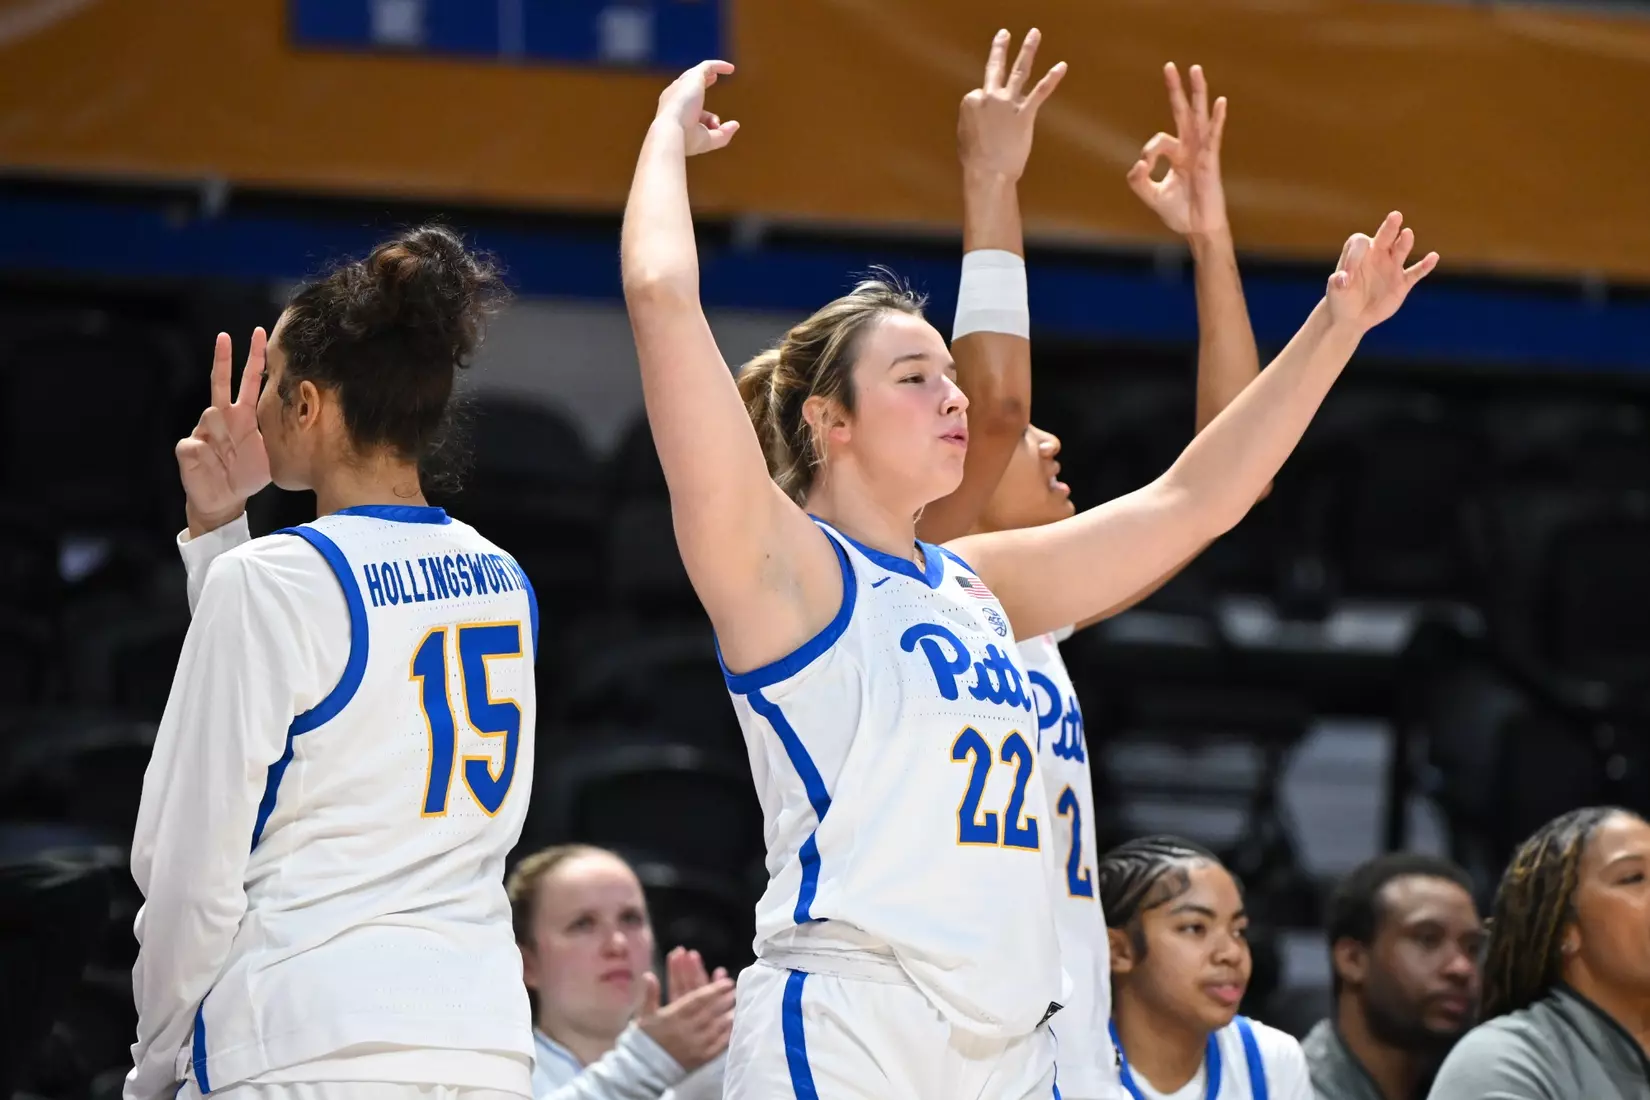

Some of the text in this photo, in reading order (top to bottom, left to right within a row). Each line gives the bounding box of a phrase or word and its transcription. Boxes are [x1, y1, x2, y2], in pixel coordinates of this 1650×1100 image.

[408, 619, 524, 818] 15
[900, 622, 1032, 713] Pitt
[950, 723, 1041, 853] 22
[1056, 782, 1095, 901] 2
